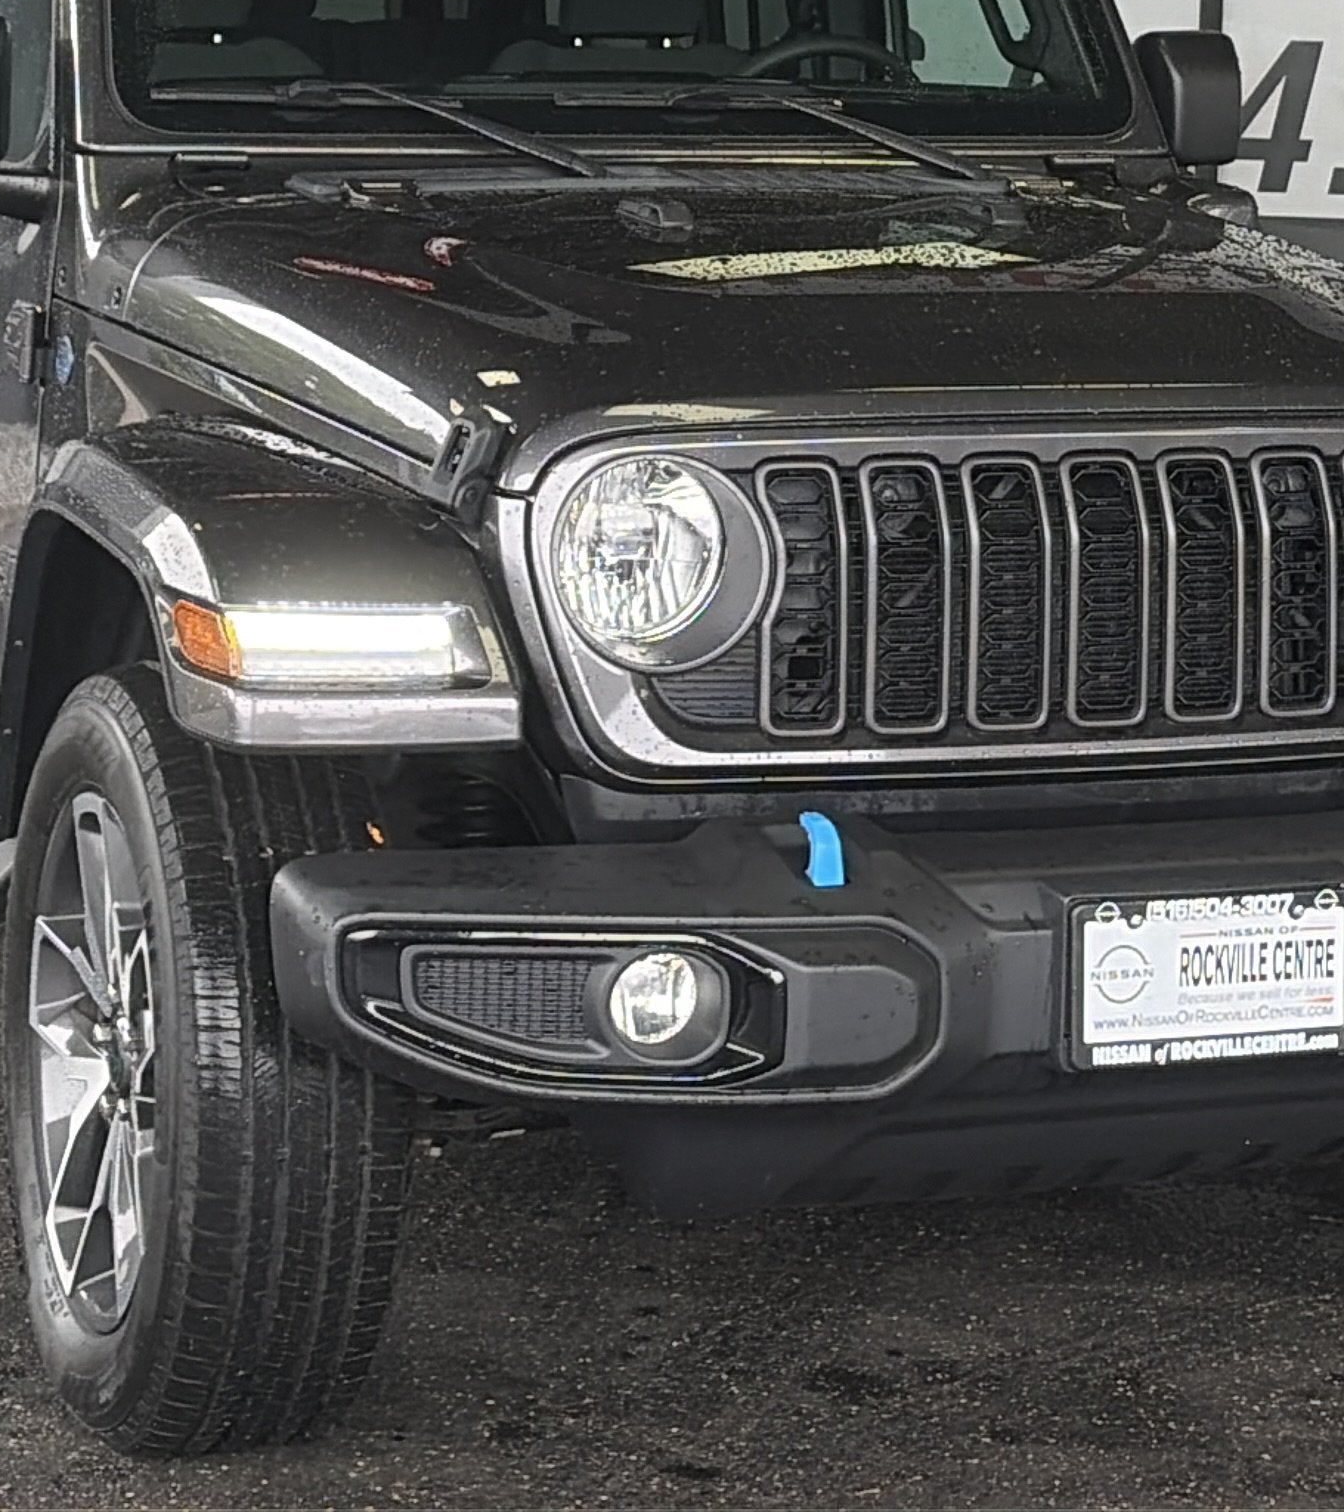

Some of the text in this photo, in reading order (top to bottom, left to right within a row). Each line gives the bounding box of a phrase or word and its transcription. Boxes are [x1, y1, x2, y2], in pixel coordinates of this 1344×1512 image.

[1218, 925, 1299, 938] NISSAN OF
[1179, 938, 1335, 988] ROCKVILLE CENTRE
[1090, 968, 1154, 981] NISSAN
[1092, 1043, 1152, 1067] NISSAN
